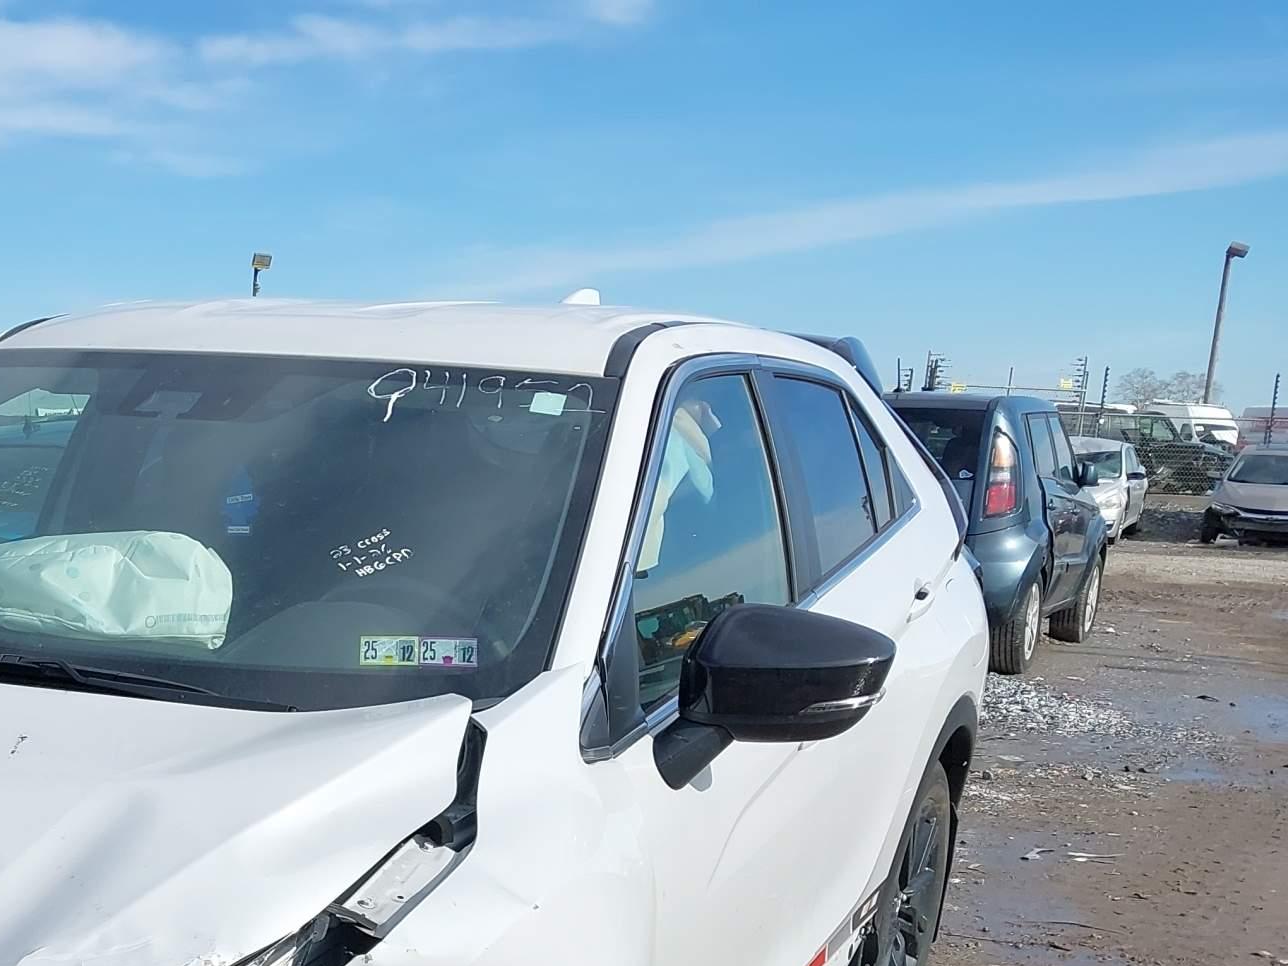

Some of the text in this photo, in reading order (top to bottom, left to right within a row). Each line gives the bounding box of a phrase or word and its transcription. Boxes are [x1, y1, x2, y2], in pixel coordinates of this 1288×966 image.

[364, 640, 412, 662] 25 12
[422, 641, 474, 663] 25 12
